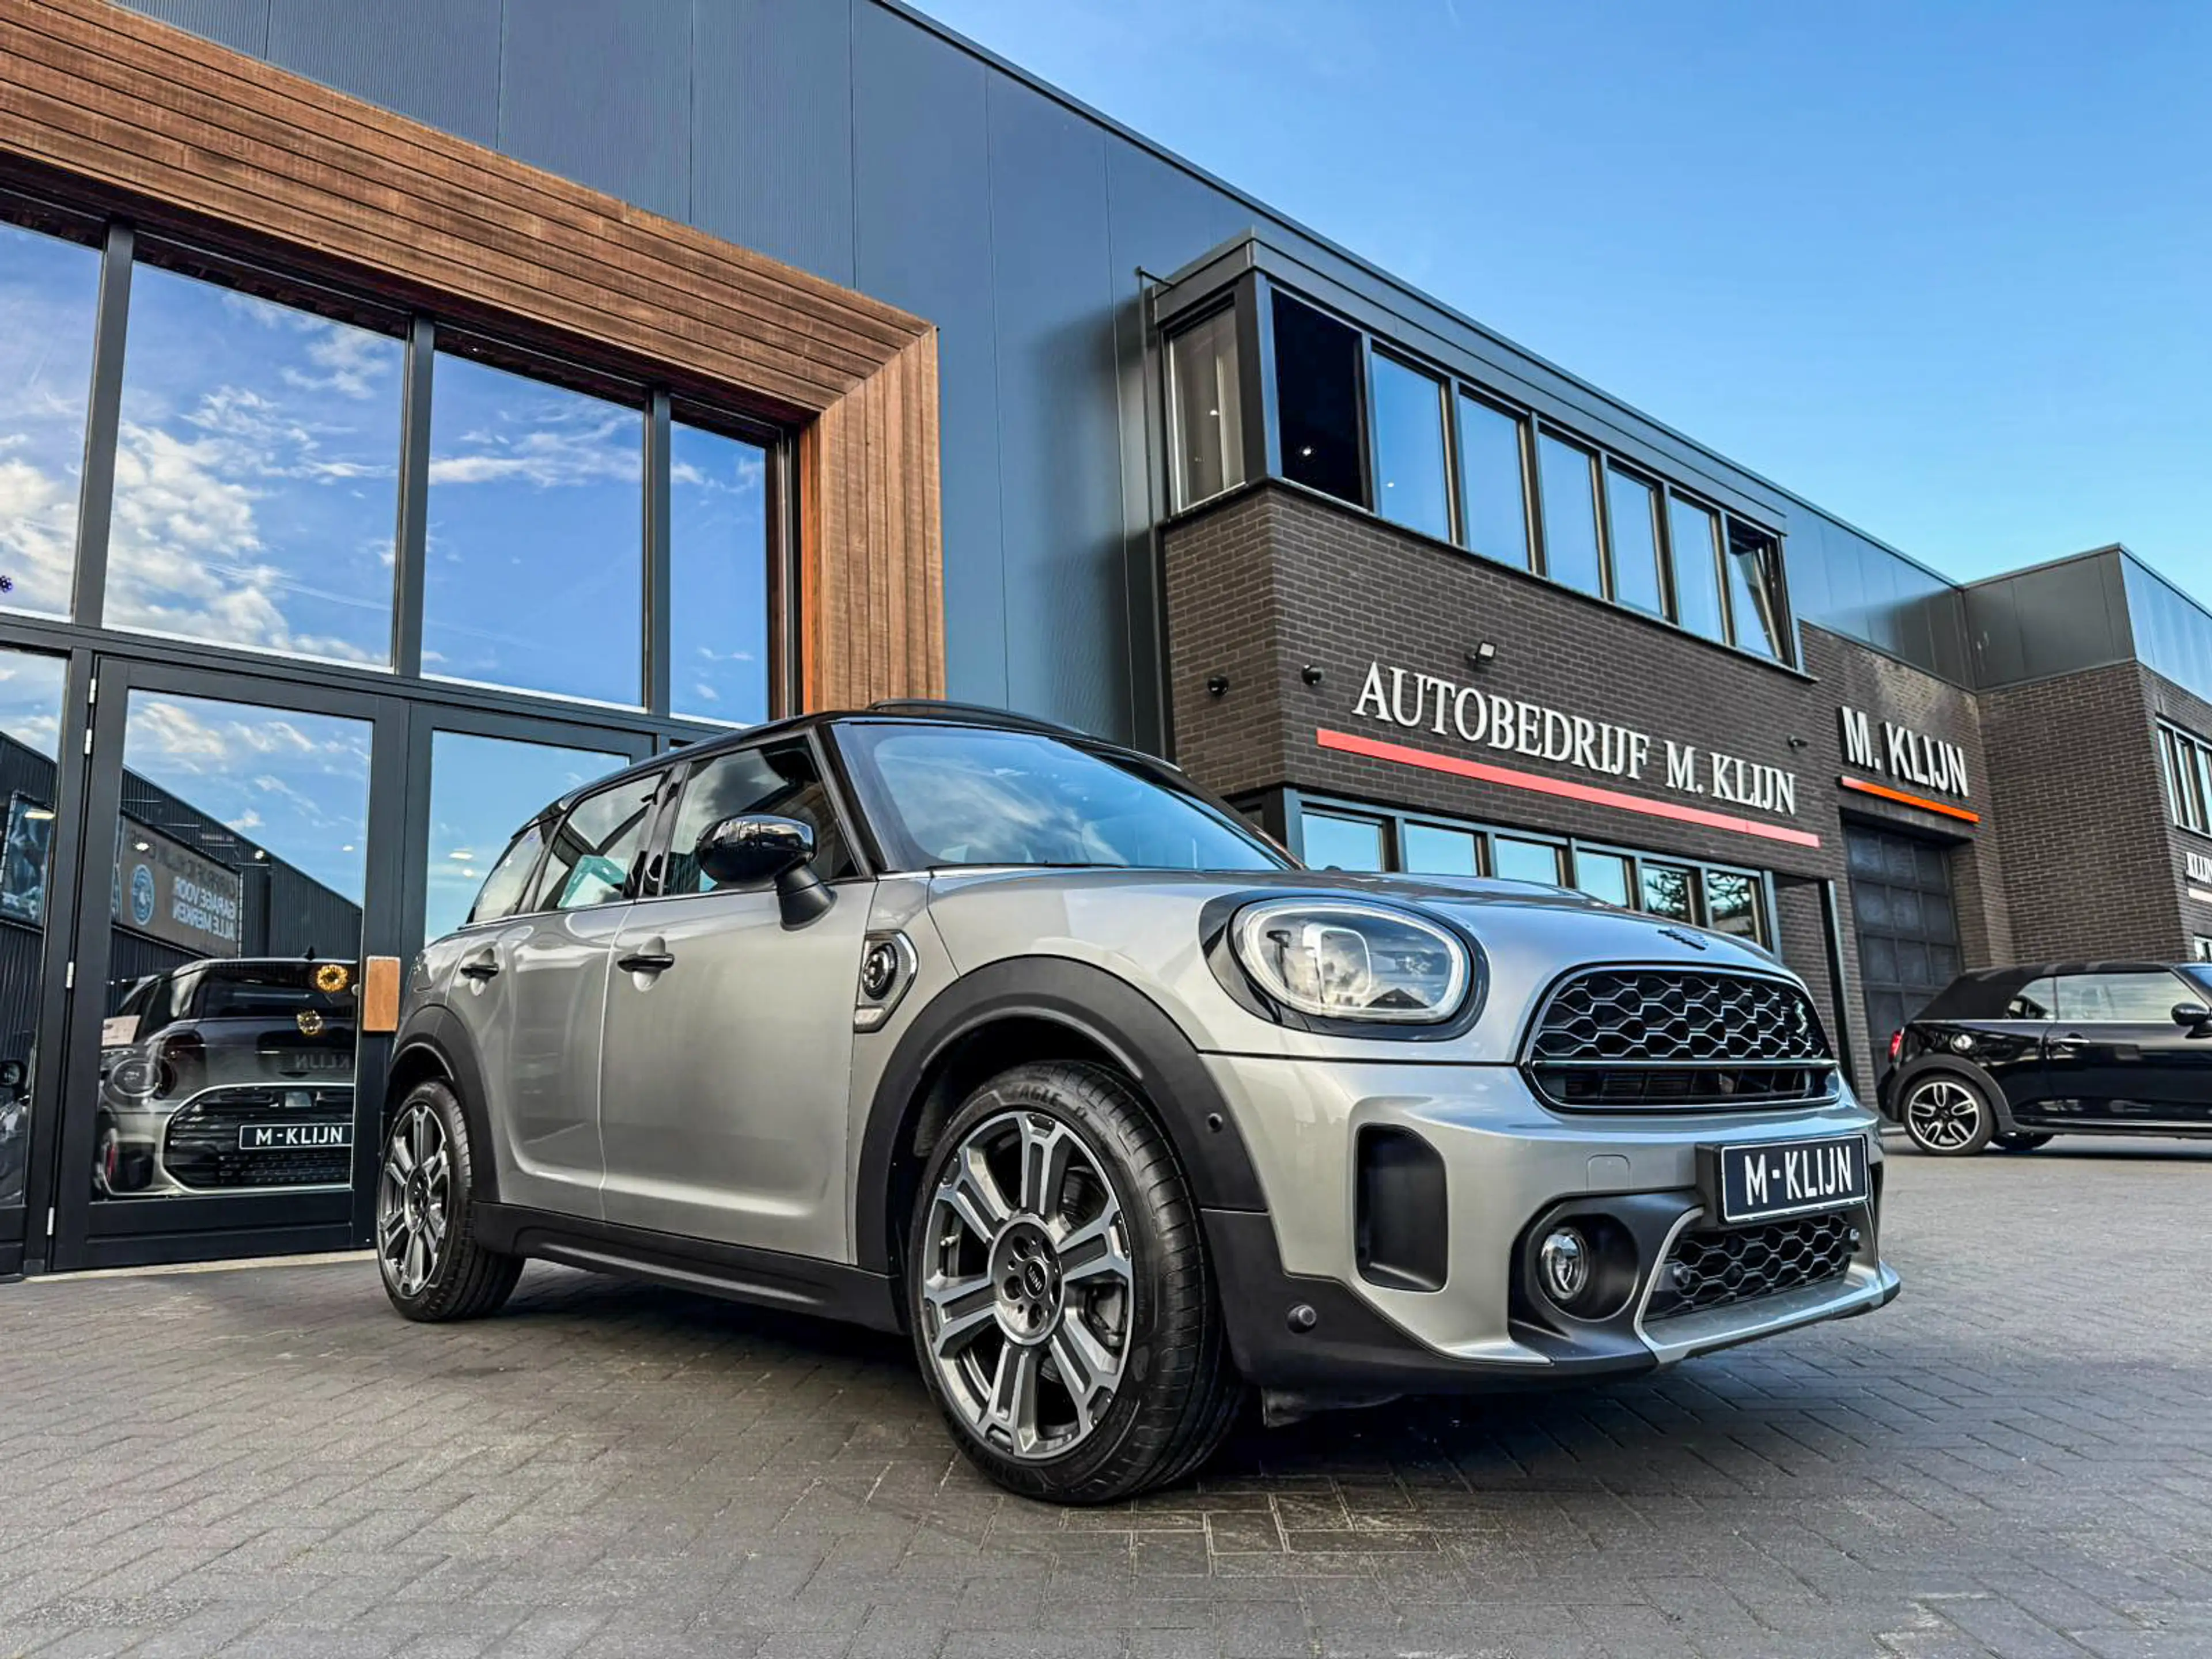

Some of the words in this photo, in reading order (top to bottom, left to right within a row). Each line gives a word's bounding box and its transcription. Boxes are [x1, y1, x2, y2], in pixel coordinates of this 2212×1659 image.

[1351, 661, 1651, 781] AUTOBEDRIJF
[1664, 740, 1703, 794] M.
[1710, 751, 1796, 816] KLIJN
[1841, 706, 1881, 771] M.
[1884, 721, 1969, 797] KLIJN
